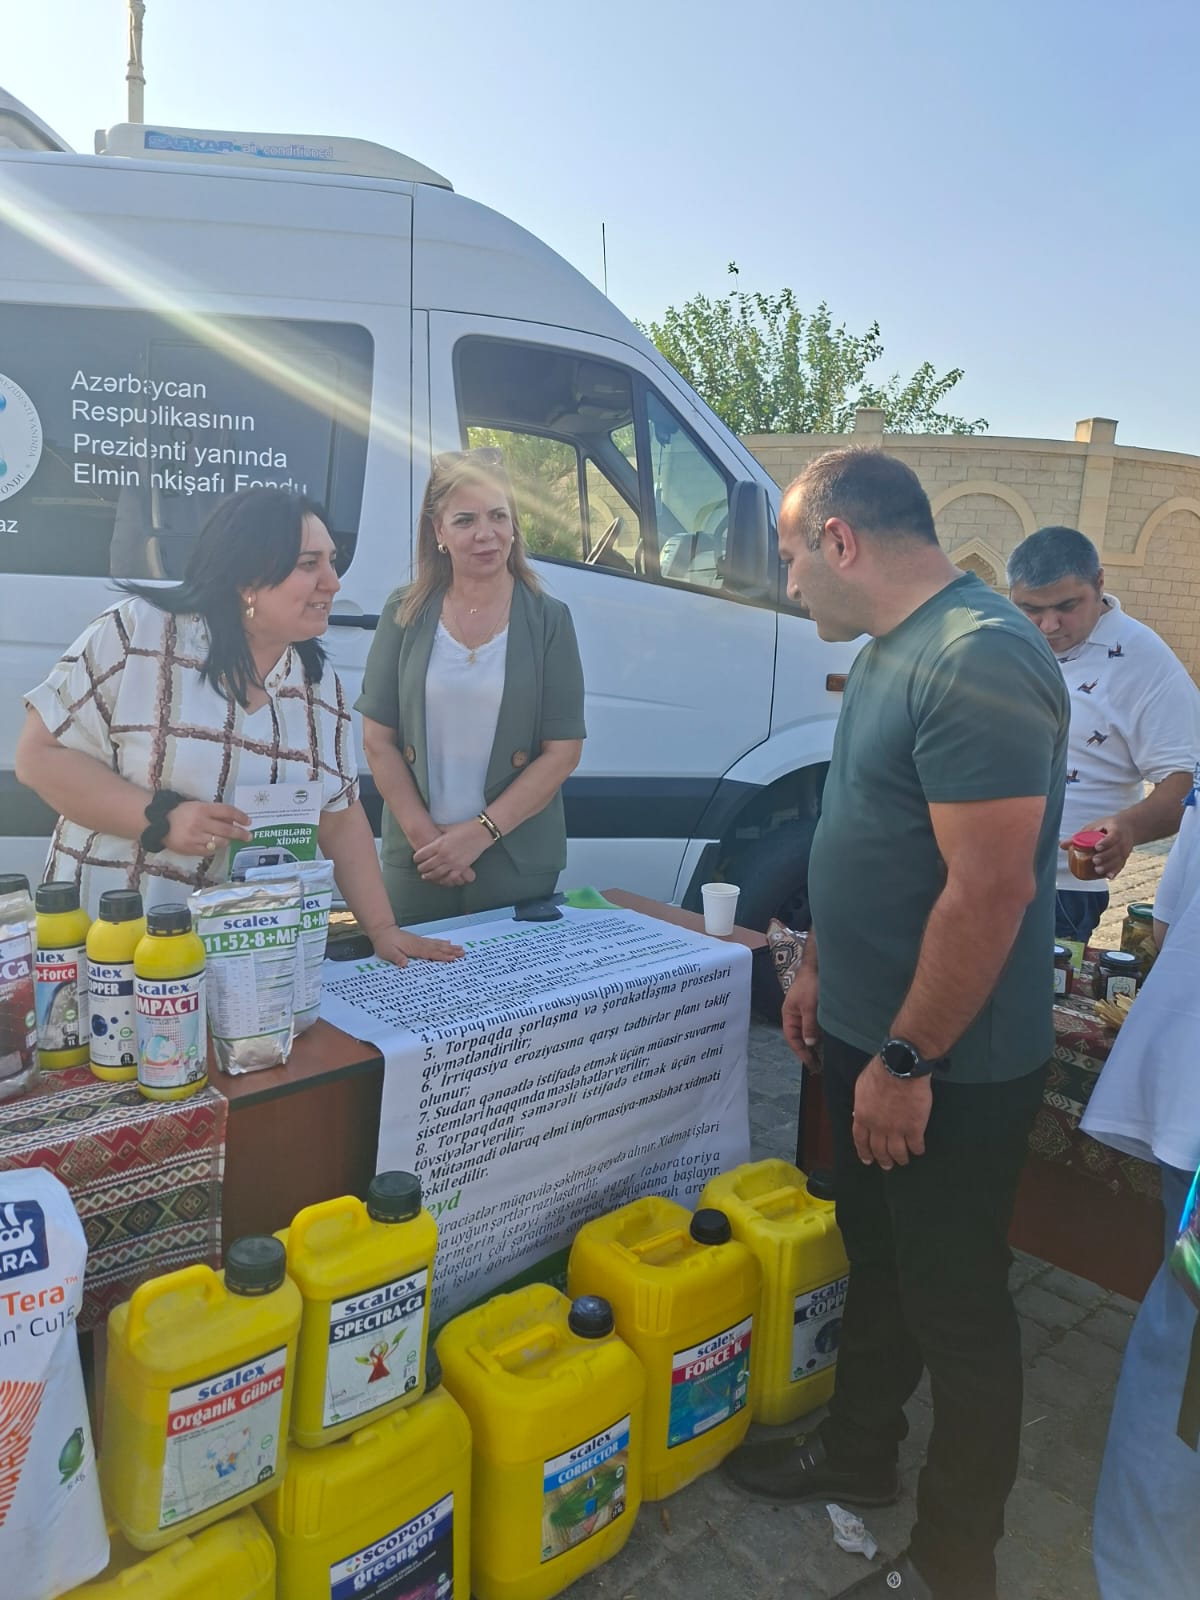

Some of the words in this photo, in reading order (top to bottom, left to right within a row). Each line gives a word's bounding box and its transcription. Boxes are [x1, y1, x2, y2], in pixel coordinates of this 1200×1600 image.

[194, 447, 288, 468] yanında
[74, 463, 140, 487] Elmin
[150, 469, 225, 496] nkişafı
[0, 519, 18, 534] az
[302, 899, 321, 910] lex
[223, 914, 279, 930] scalex
[0, 962, 30, 981] -Ca
[36, 951, 65, 963] lex
[89, 966, 122, 979] alex
[37, 967, 75, 981] -Force
[137, 983, 190, 996] scalex
[135, 994, 199, 1016] IMPACT
[380, 986, 443, 1004] Torpaqda
[398, 995, 460, 1013] Torpağın
[420, 1034, 434, 1044] 4.
[438, 1021, 484, 1039] Torpaq
[540, 990, 597, 1012] reaksiyası
[600, 983, 622, 999] (pH)
[423, 1046, 436, 1062] 5.
[447, 1026, 512, 1054] Torpaqda
[520, 1010, 577, 1036] şorlaşma
[585, 1005, 596, 1015] və
[603, 982, 675, 1013] şorakətləşmə
[681, 966, 730, 992] prosesləri
[421, 1079, 433, 1093] 6.
[442, 1060, 507, 1086] İrriqasiya
[515, 1037, 584, 1064] eroziyasına
[590, 1027, 618, 1044] qarşı
[624, 1012, 670, 1032] tədbirlər
[705, 992, 730, 1008] təklif
[423, 1038, 531, 1079] qiymətləndirilir;
[418, 1111, 431, 1125] 7.
[434, 1099, 475, 1119] Sudan
[480, 1079, 533, 1107] qənaətlə
[537, 1065, 580, 1086] istifadə
[584, 1052, 617, 1071] etmək
[620, 1046, 644, 1060] üçün
[648, 1034, 682, 1051] müasir
[684, 1021, 725, 1040] suvarma
[415, 1143, 428, 1157] 8.
[439, 1116, 513, 1148] Torpaqdan
[521, 1093, 576, 1120] səmərəli
[583, 1077, 626, 1099] istifadə
[633, 1063, 665, 1082] etmək
[672, 1055, 695, 1070] üçün
[701, 1047, 722, 1059] elmi
[417, 1106, 484, 1141] sistemləri
[486, 1090, 544, 1117] haqqında
[547, 1070, 613, 1097] məsləhətlər
[616, 1058, 649, 1075] verilir;
[420, 1086, 470, 1108] olunur;
[431, 1147, 496, 1178] Mütəmadi
[500, 1136, 540, 1156] olaraq
[543, 1122, 568, 1140] elmi
[571, 1084, 682, 1131] informasiya-məsləhət
[686, 1070, 720, 1089] xidməti
[415, 1142, 480, 1171] tövsiyələr
[483, 1126, 524, 1147] verilir;
[423, 1178, 449, 1198] şkil
[452, 1168, 487, 1188] edilir.
[438, 1204, 498, 1235] üraciətlər
[499, 1183, 552, 1211] müqavilə
[692, 1121, 720, 1138] işləri
[432, 1254, 482, 1282] kdaşları
[673, 1166, 721, 1182] başlayır.
[435, 1234, 495, 1266] ermerin
[641, 1152, 720, 1177] laboratoriya
[451, 1223, 488, 1243] uyğun
[491, 1205, 532, 1231] şərtlər
[0, 1249, 38, 1273] RA
[344, 1278, 418, 1317] scalex
[806, 1291, 847, 1319] COPP
[333, 1295, 423, 1341] SPECTRA-Ca
[697, 1331, 736, 1358] scalex
[685, 1348, 730, 1380] FORCE
[198, 1362, 267, 1402] scalex
[172, 1396, 237, 1432] Organik
[241, 1375, 283, 1406] Gübre
[558, 1440, 619, 1485] CORRECTOR
[569, 1431, 613, 1464] scalex
[362, 1507, 440, 1565] SCOPOLY
